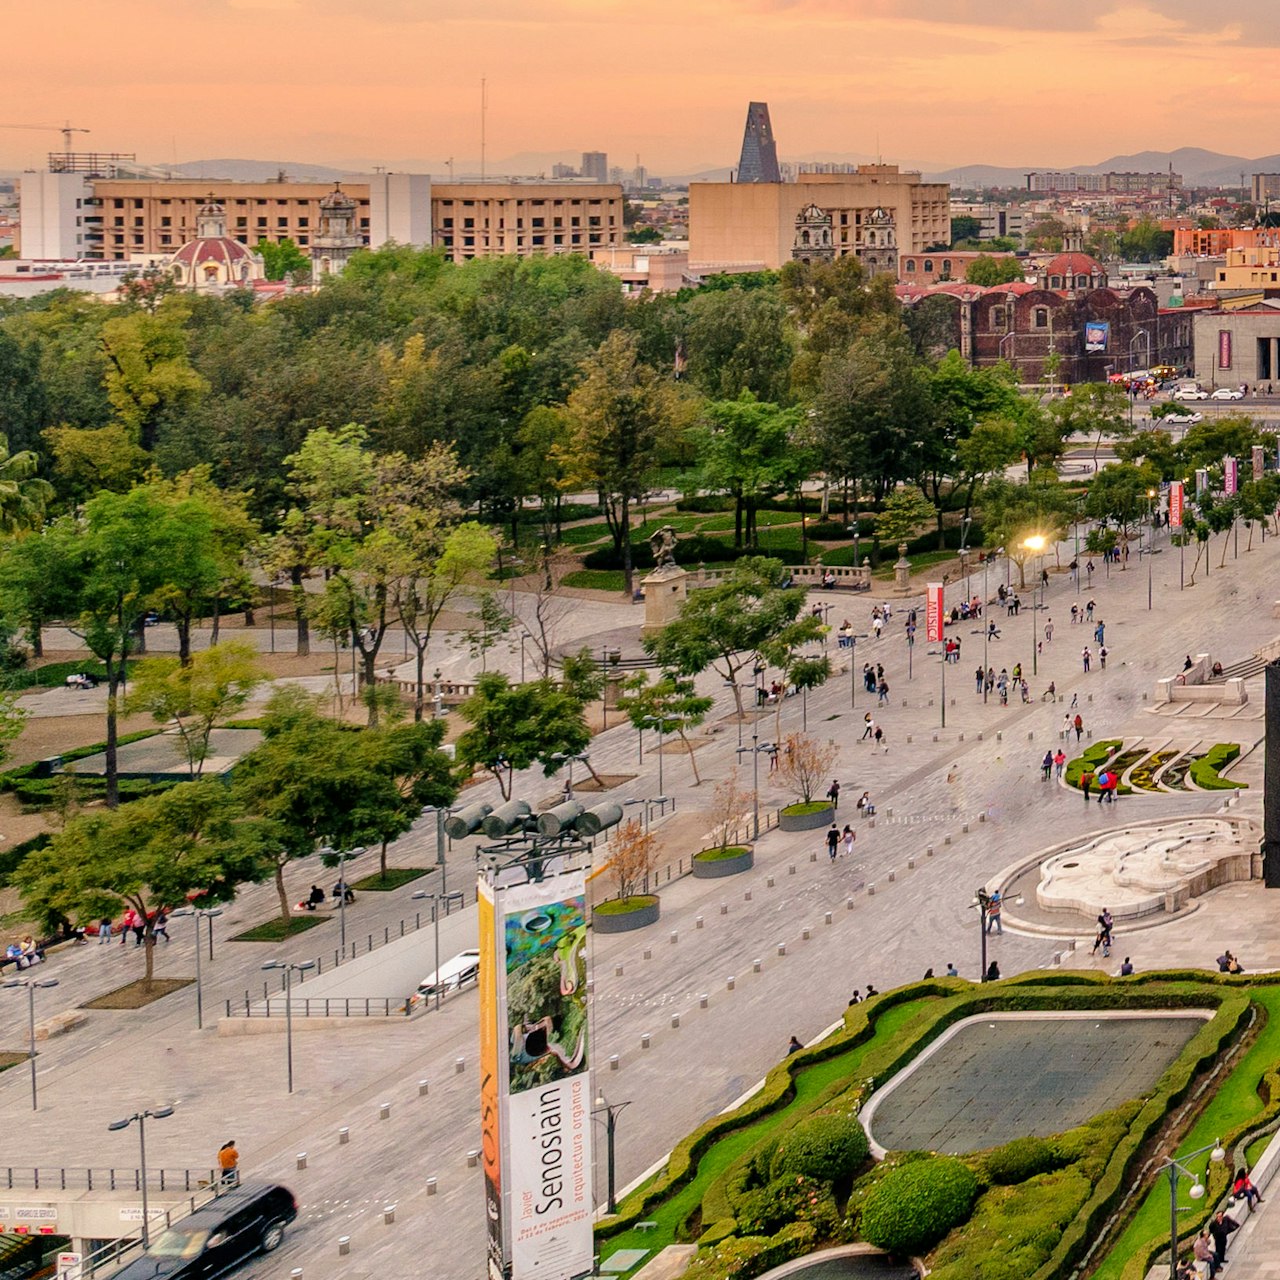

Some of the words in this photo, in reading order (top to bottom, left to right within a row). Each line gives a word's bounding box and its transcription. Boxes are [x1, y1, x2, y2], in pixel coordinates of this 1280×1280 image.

[570, 1080, 584, 1130] orgánica
[532, 1087, 563, 1216] Senosiain
[572, 1133, 585, 1204] arquitectura
[521, 1191, 533, 1220] Javier
